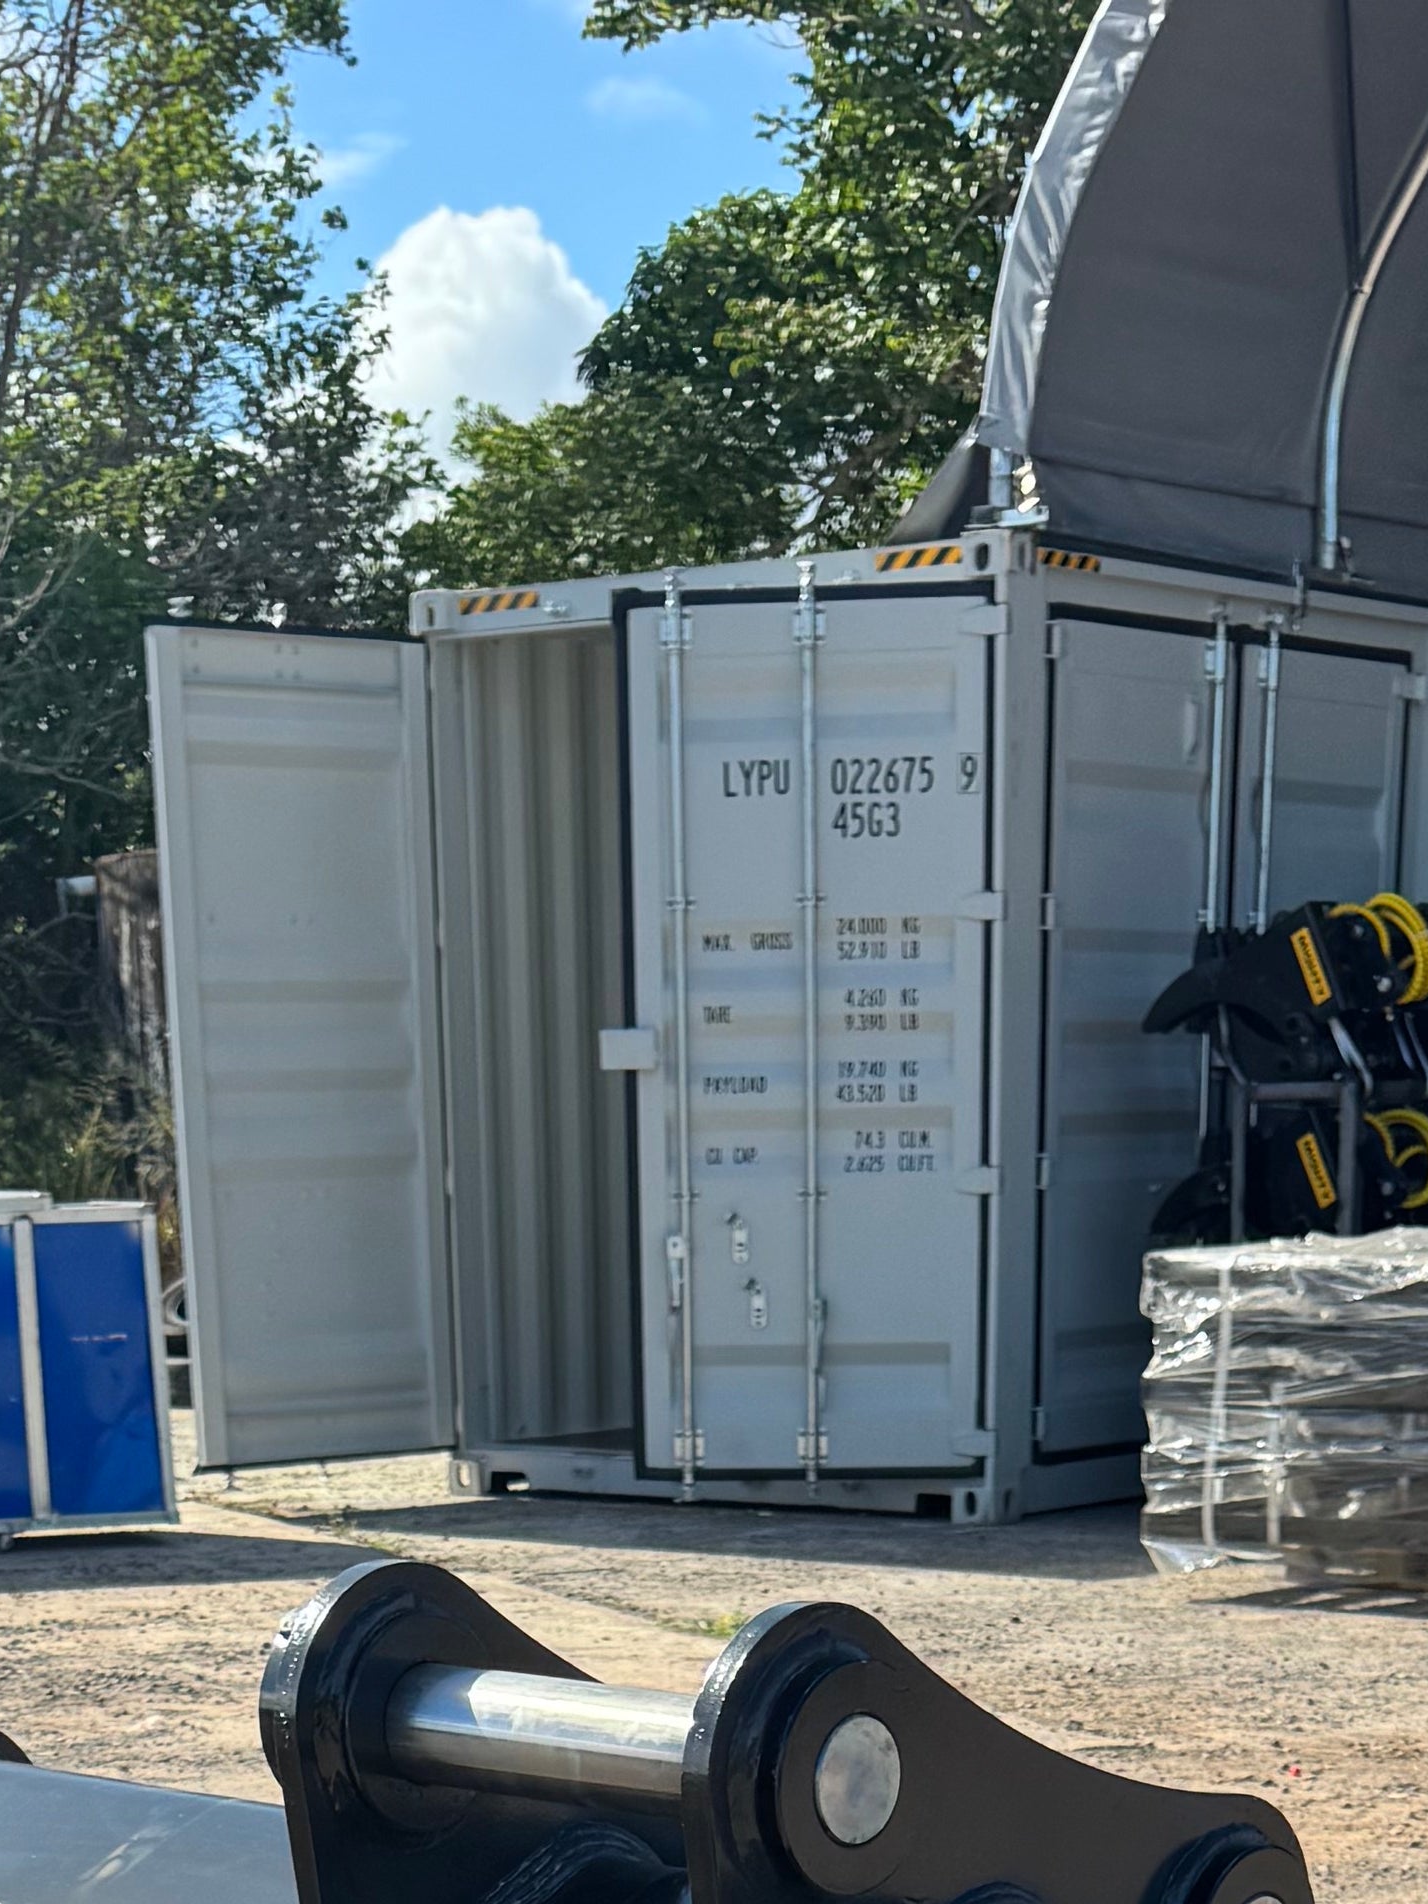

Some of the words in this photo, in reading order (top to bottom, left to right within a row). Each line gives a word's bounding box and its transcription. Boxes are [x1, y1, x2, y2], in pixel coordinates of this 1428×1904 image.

[722, 759, 791, 798] LYPU
[830, 755, 935, 795] 022675
[959, 755, 979, 791] 9
[832, 802, 901, 838] 45G3
[750, 932, 794, 951] GROSS
[901, 940, 921, 960] LB
[900, 1012, 920, 1031] LB
[703, 1076, 769, 1095] PAYLOAD
[899, 1083, 918, 1102] LB
